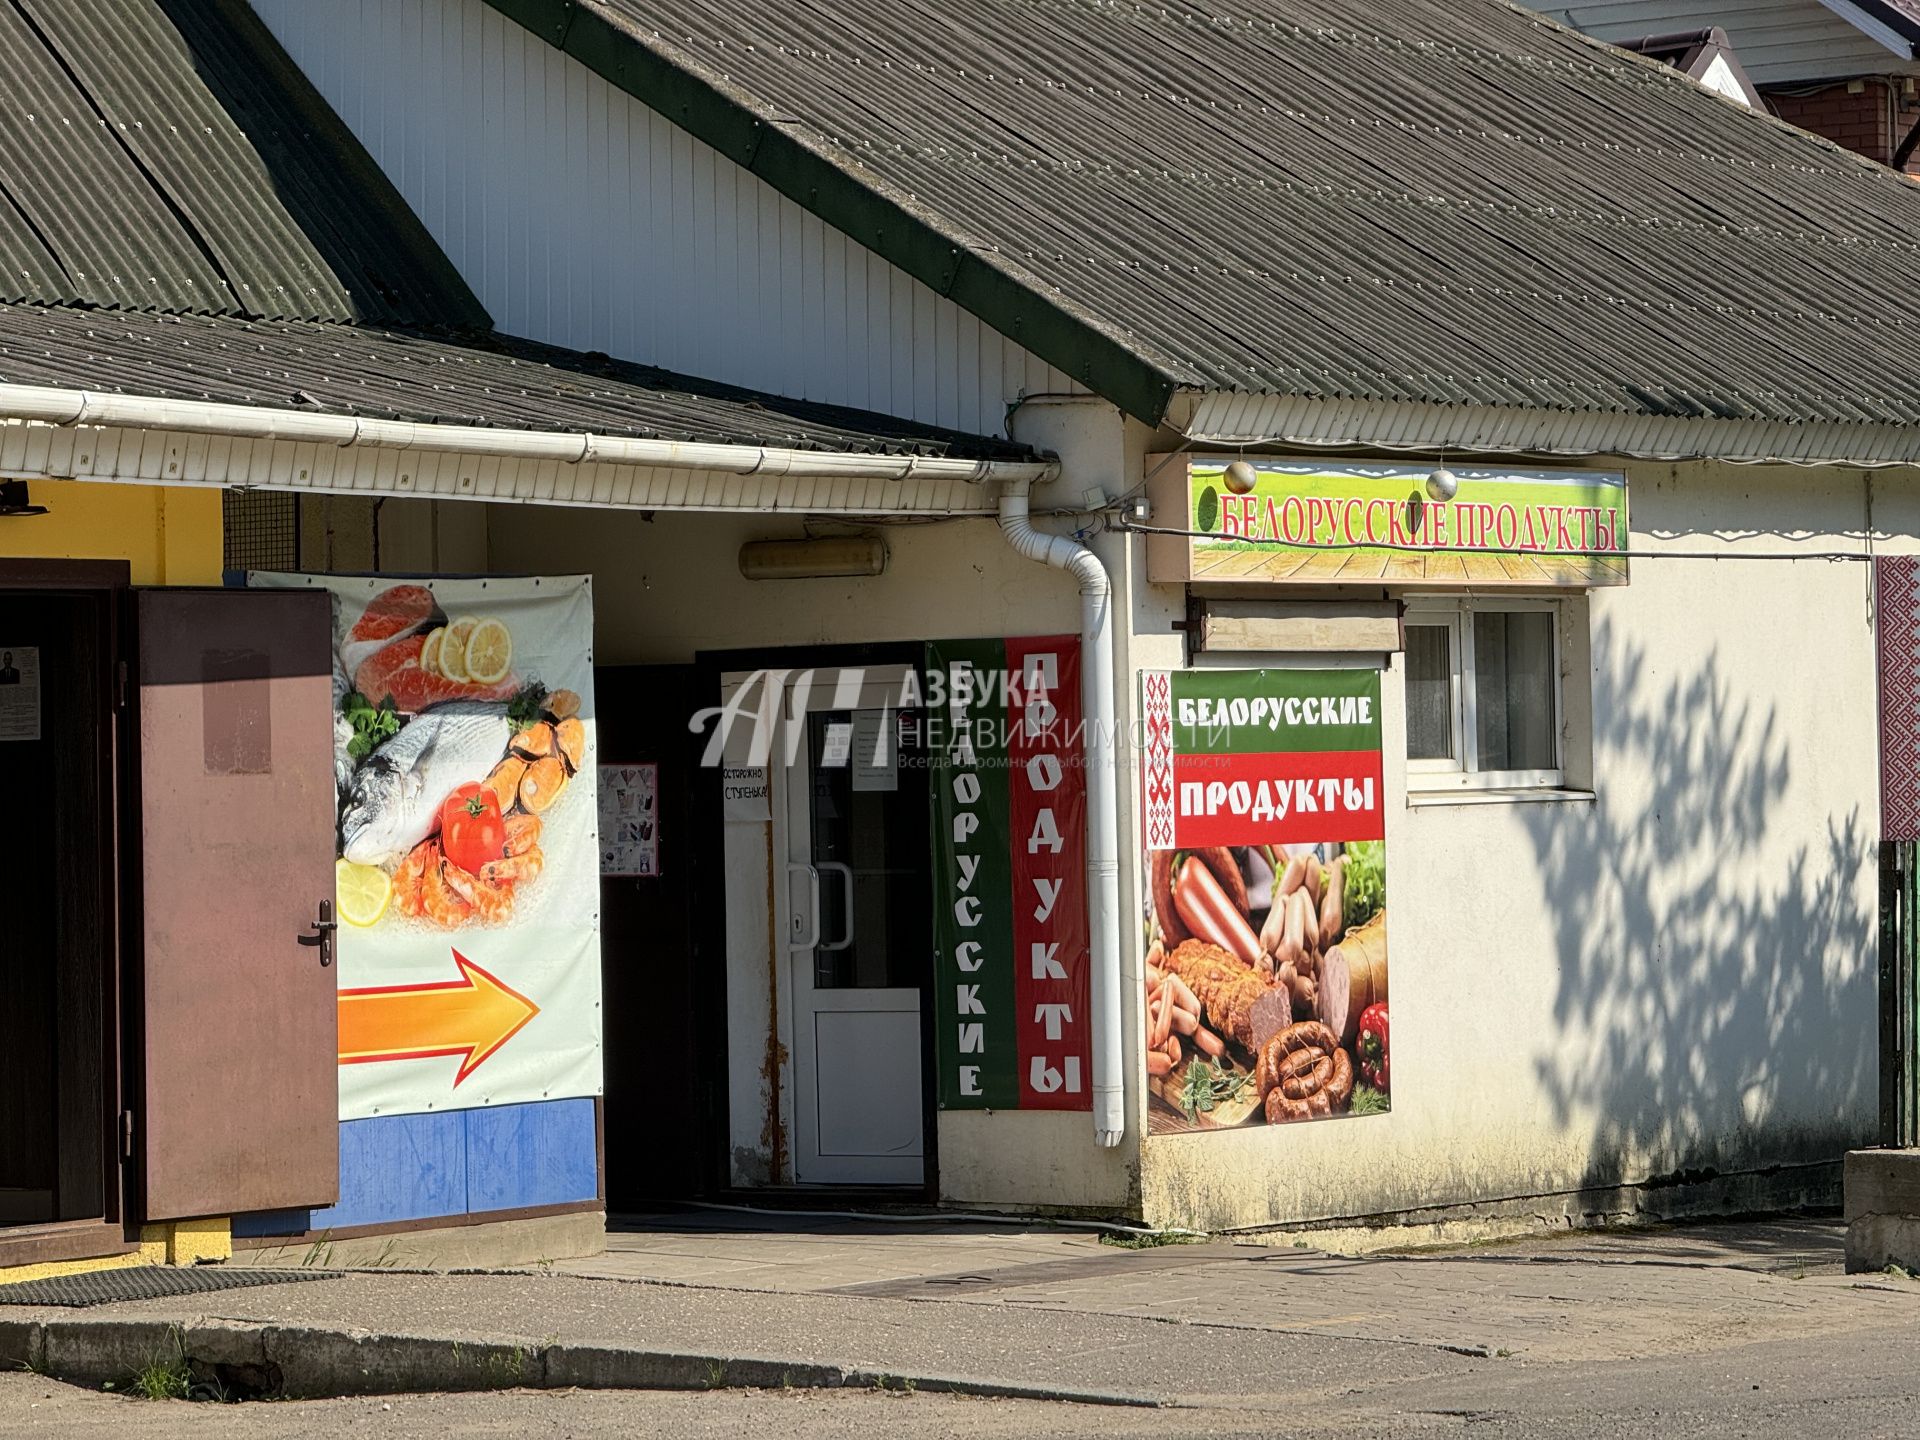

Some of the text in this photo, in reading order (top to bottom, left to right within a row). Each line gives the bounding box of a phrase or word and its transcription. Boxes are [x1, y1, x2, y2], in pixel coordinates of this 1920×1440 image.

[1219, 494, 1618, 557] БЕЛОРУССКИЕ ПРОДУКТЫ
[1178, 696, 1373, 732] БЕЛОРУССКИЕ
[1180, 777, 1375, 822] ПРОДУКТЫ
[948, 659, 987, 1096] БЕЛОРУССКИЕ
[1023, 652, 1082, 1094] ПРОДУКТЫ
